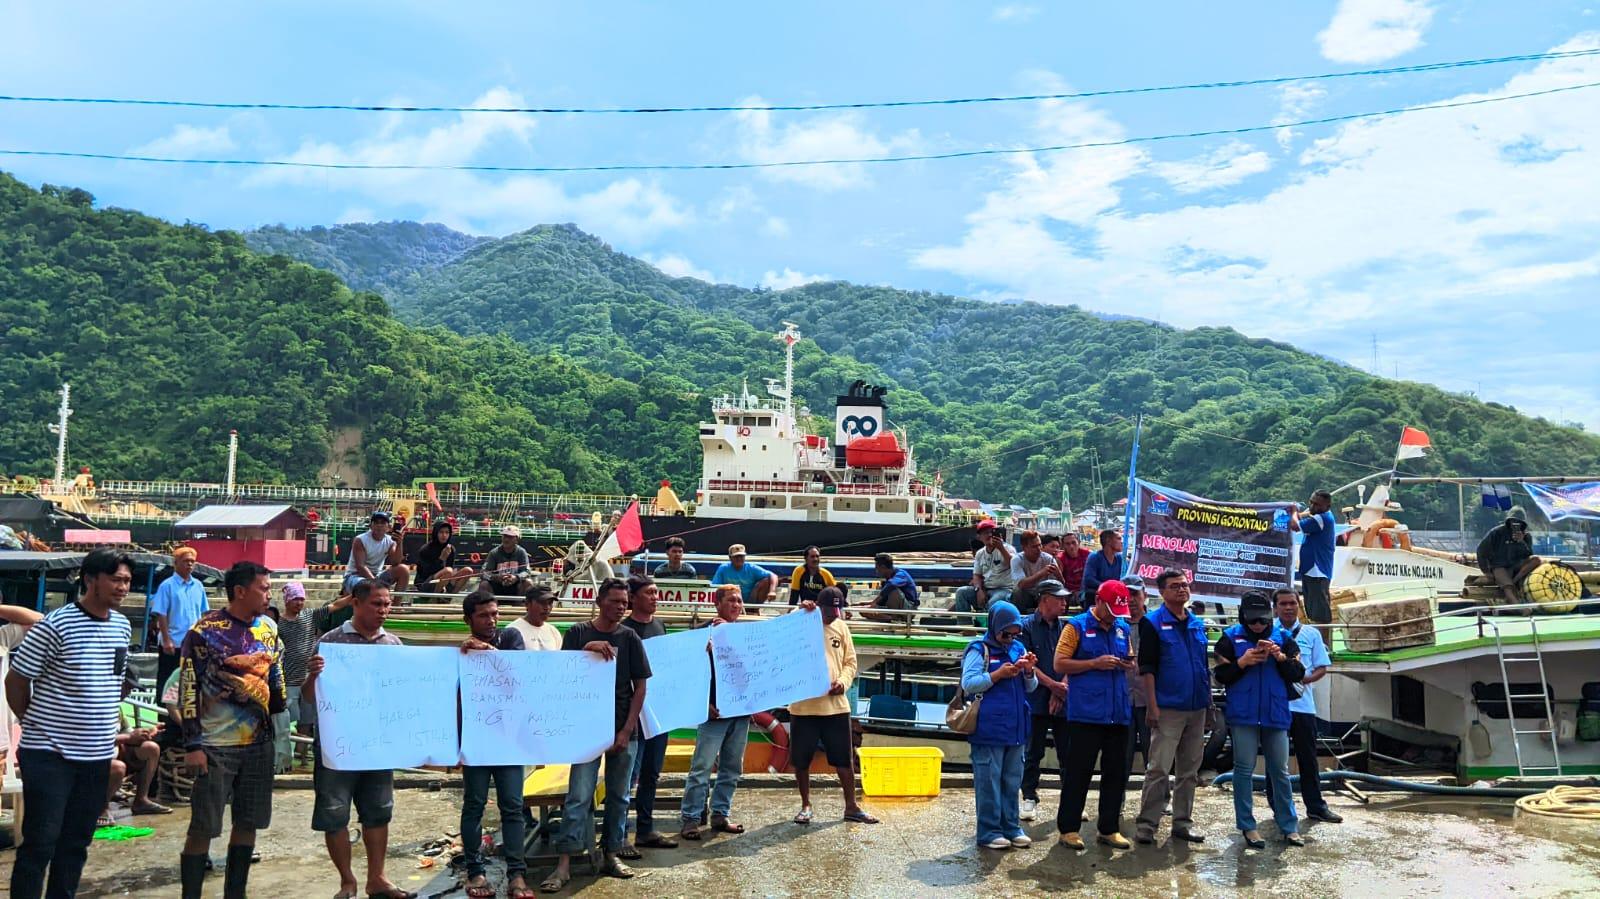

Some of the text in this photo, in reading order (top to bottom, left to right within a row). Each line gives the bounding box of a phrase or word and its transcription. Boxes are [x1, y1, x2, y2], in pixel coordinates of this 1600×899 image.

[1177, 508, 1220, 525] PROVINSI
[1220, 515, 1268, 532] GORONTALO
[1142, 534, 1198, 554] MENOLAK
[1368, 562, 1375, 574] GT
[1376, 563, 1384, 575] 32
[1385, 563, 1398, 576] 2017
[572, 587, 593, 604] KM
[656, 590, 682, 607] AGA
